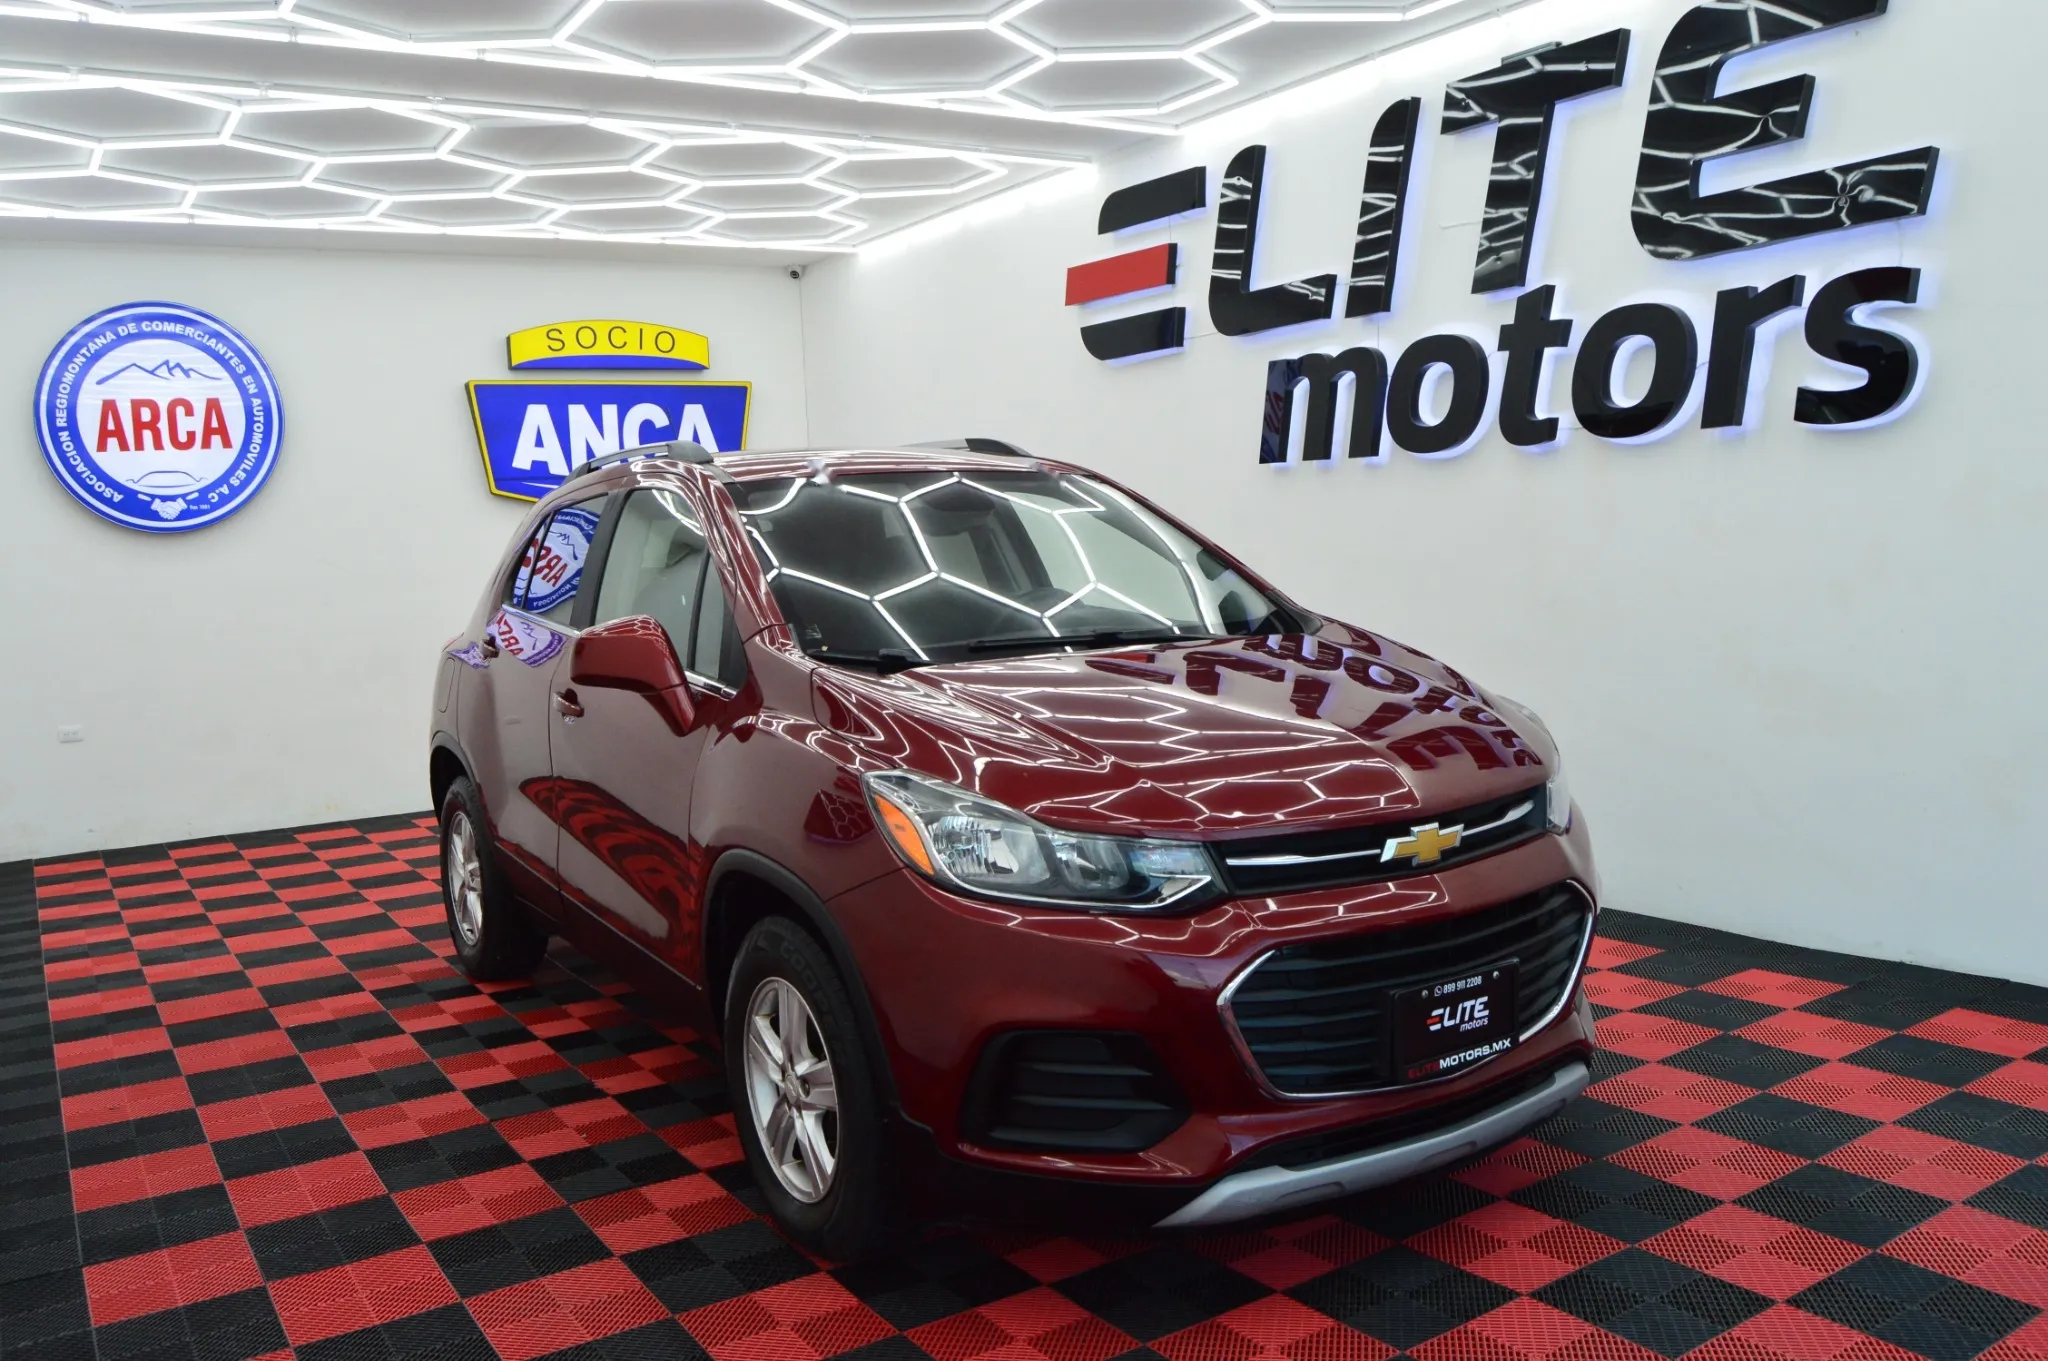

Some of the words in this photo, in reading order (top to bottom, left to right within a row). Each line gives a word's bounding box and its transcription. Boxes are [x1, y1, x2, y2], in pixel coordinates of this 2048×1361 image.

[1065, 0, 1939, 361] ELITE
[119, 322, 138, 337] DE
[141, 321, 246, 374] COMERCIANTES
[546, 325, 676, 354] SOCIO
[56, 332, 116, 426] REGIOMONTANA
[243, 375, 257, 394] EN
[1259, 266, 1921, 465] motors
[96, 397, 233, 453] ARCA
[231, 398, 263, 487] AUTOMOVILES
[512, 402, 719, 476] ANCA
[59, 431, 123, 502] ASOCIACION
[1427, 996, 1489, 1031] ELITE
[1443, 983, 1455, 994] 899
[1460, 1017, 1488, 1032] motors
